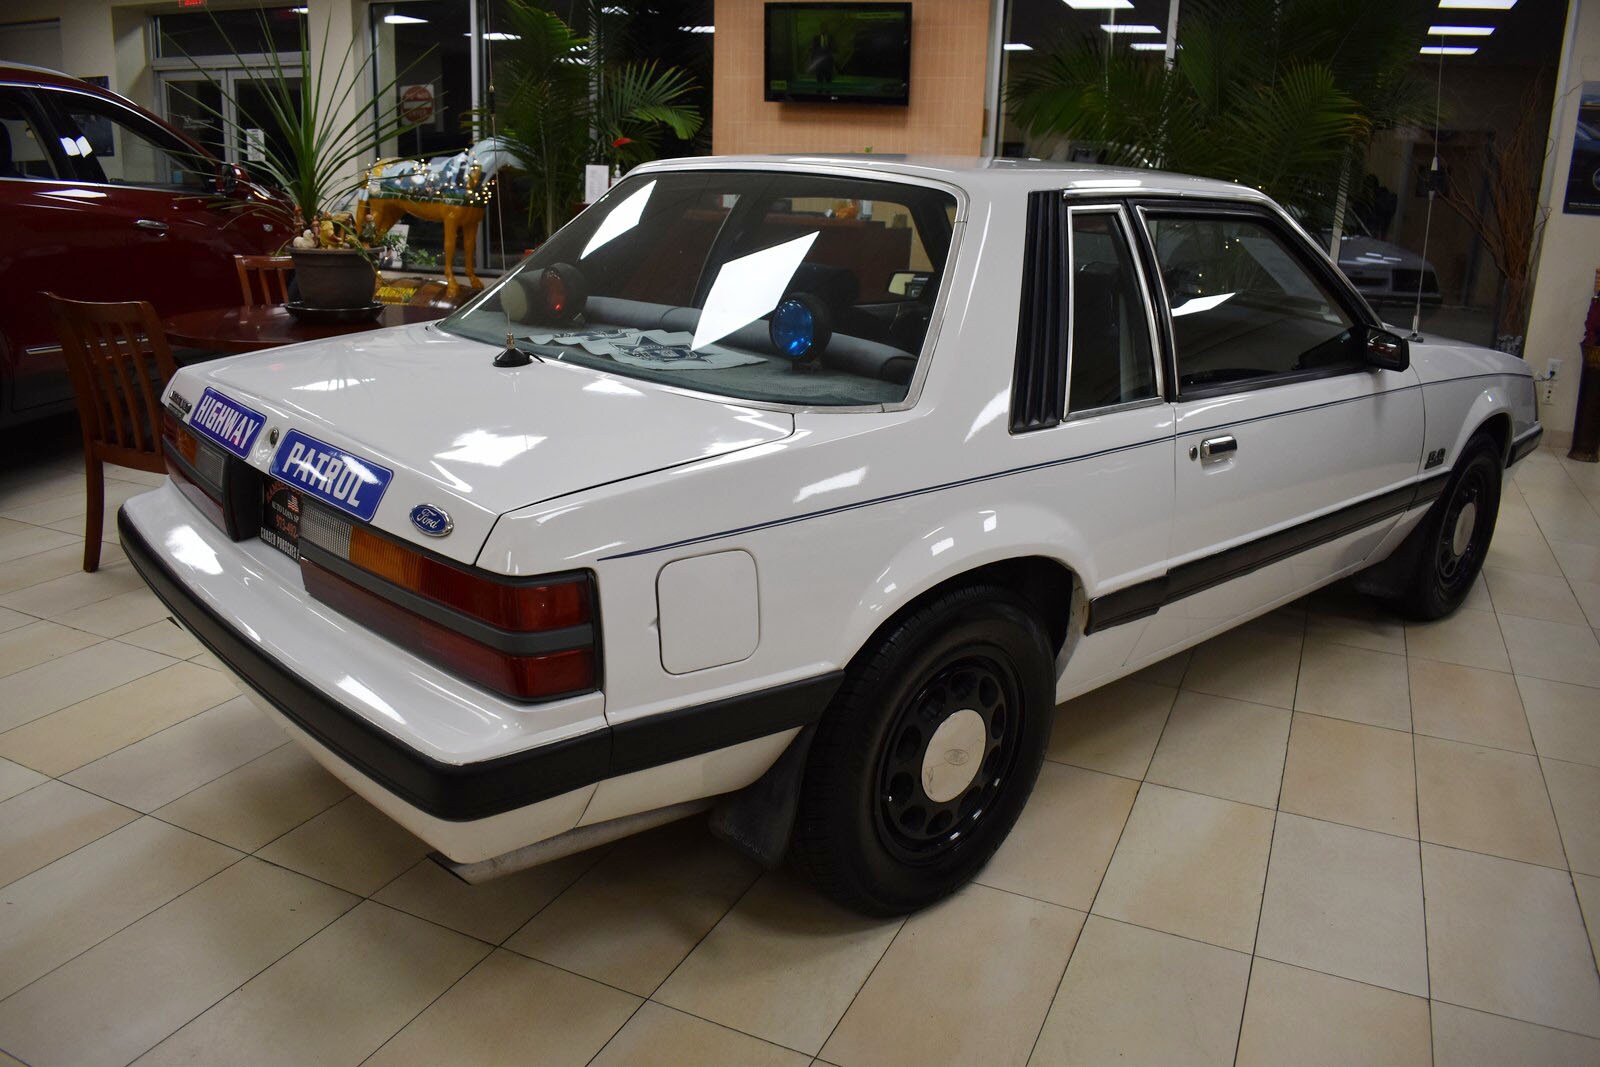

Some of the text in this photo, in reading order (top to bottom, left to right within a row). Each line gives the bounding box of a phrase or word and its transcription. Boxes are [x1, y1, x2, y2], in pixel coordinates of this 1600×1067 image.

[194, 395, 259, 449] HIGHWAY
[282, 441, 360, 507] PATROL
[416, 508, 440, 528] Ford
